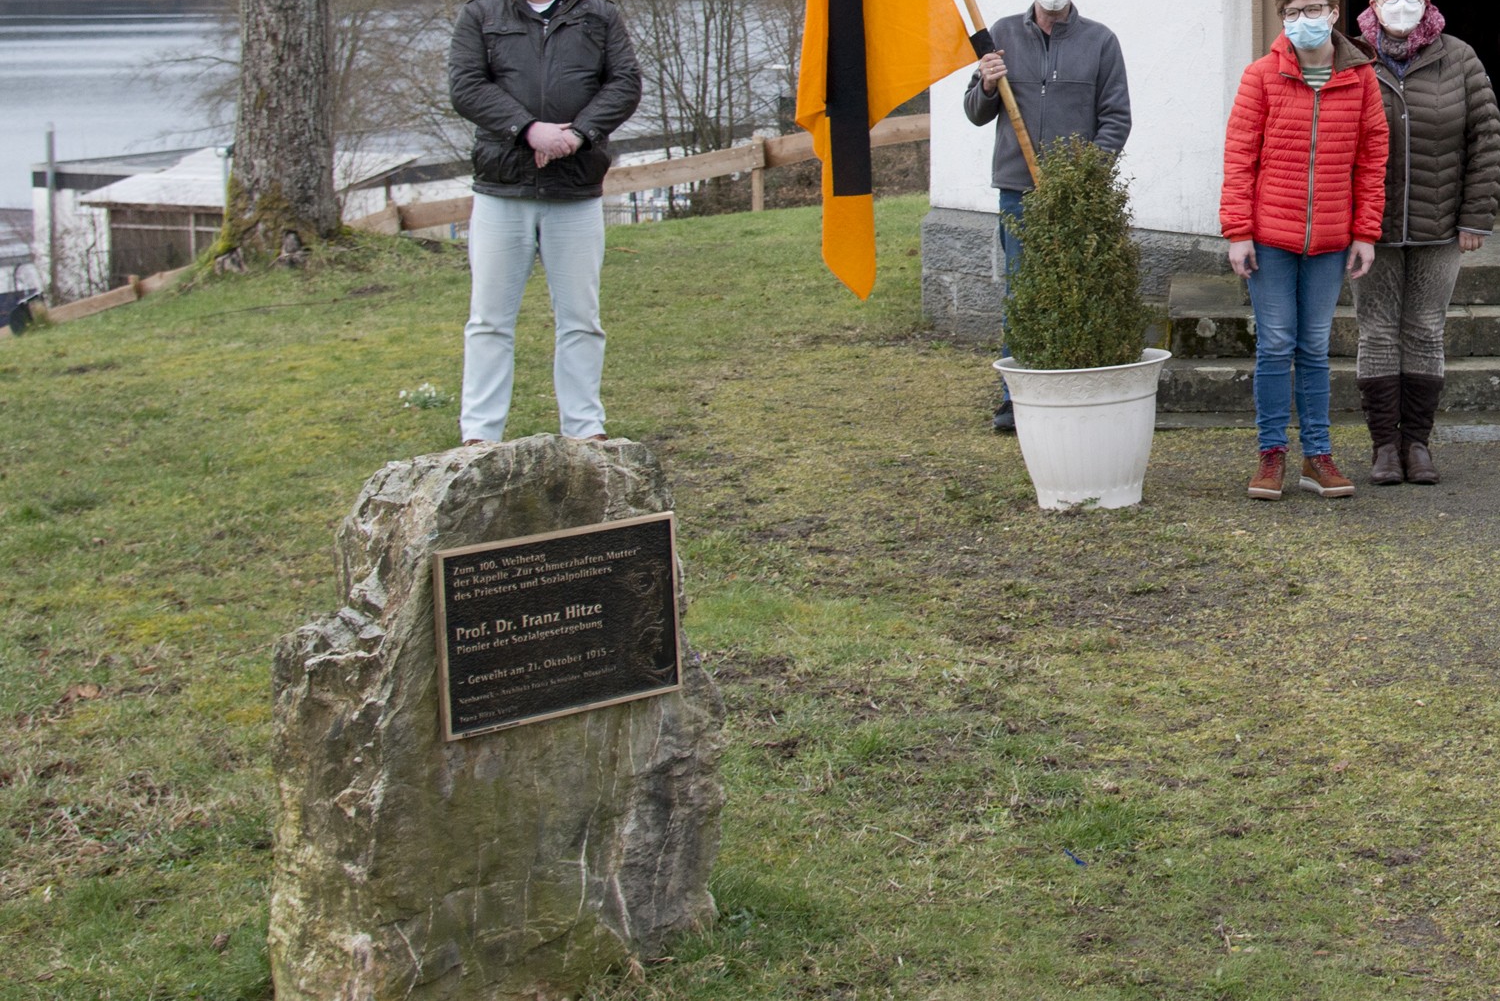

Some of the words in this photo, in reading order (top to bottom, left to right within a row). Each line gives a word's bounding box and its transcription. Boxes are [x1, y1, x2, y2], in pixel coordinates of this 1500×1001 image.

[453, 566, 474, 576] Zum
[480, 561, 498, 571] 100.
[502, 554, 546, 567] Weihetag
[453, 579, 469, 588] der
[473, 571, 509, 585] Kapelle
[535, 555, 604, 573] schmerzhaften
[454, 591, 471, 601] des
[474, 583, 517, 597] Priesters
[520, 578, 538, 589] und
[541, 565, 612, 585] Sozialpolitikers
[456, 622, 491, 641] Prof.
[496, 619, 517, 633] Dr.
[522, 611, 561, 628] Franz
[565, 603, 602, 619] Hitze
[456, 642, 490, 655] Pionier
[493, 637, 509, 648] der
[512, 620, 603, 644] Sozialgesetzgebung
[468, 669, 508, 685] Geweiht
[509, 666, 525, 676] am
[528, 662, 541, 672] 21.
[543, 655, 582, 669] Oktober
[586, 647, 607, 659] 1915
